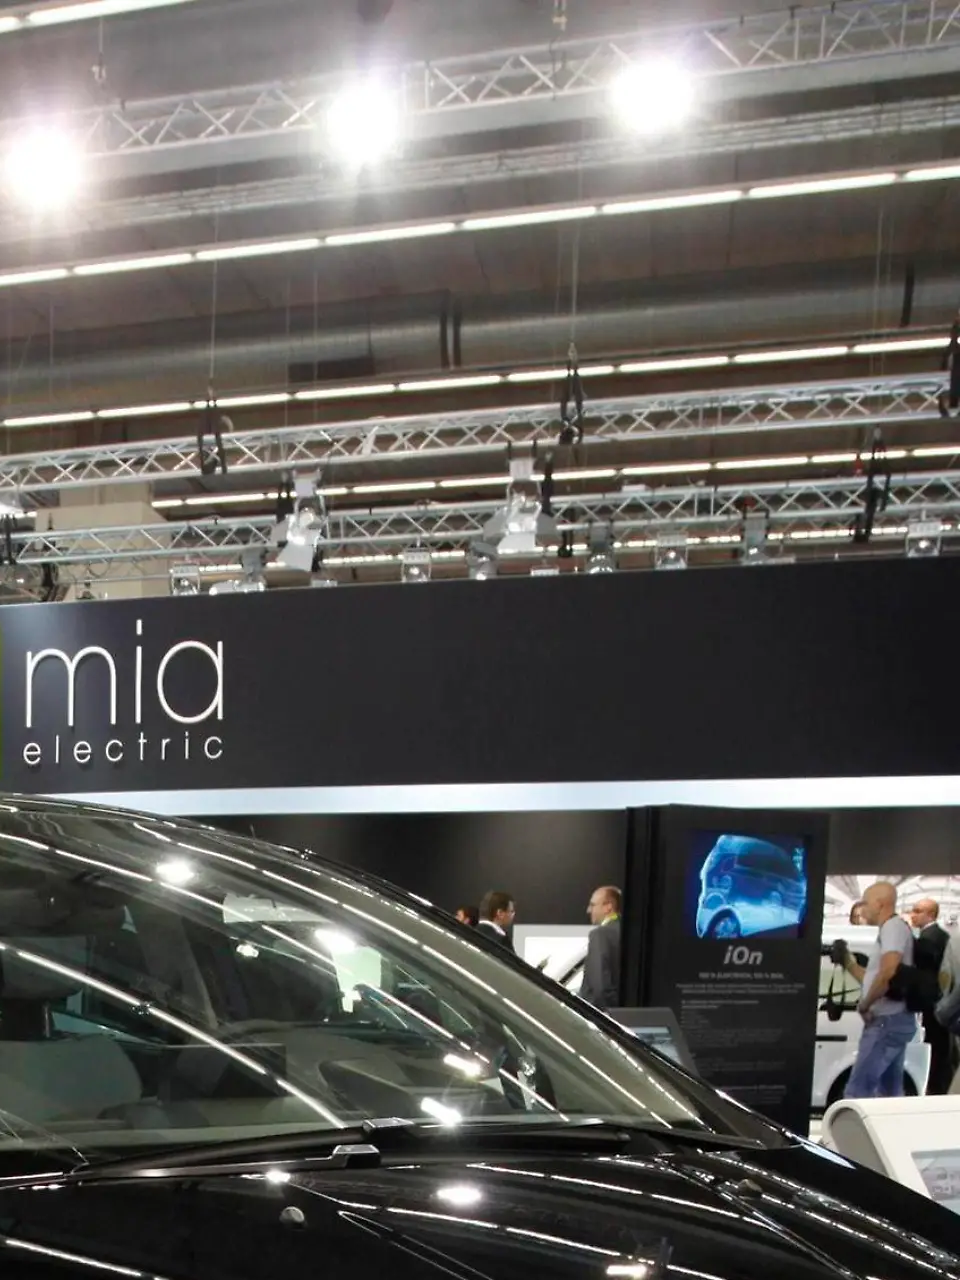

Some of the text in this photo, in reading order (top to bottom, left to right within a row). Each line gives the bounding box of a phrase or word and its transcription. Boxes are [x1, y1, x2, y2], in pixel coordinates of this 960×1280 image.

[26, 619, 223, 727] mia
[23, 732, 223, 765] electric
[724, 945, 763, 965] iOn
